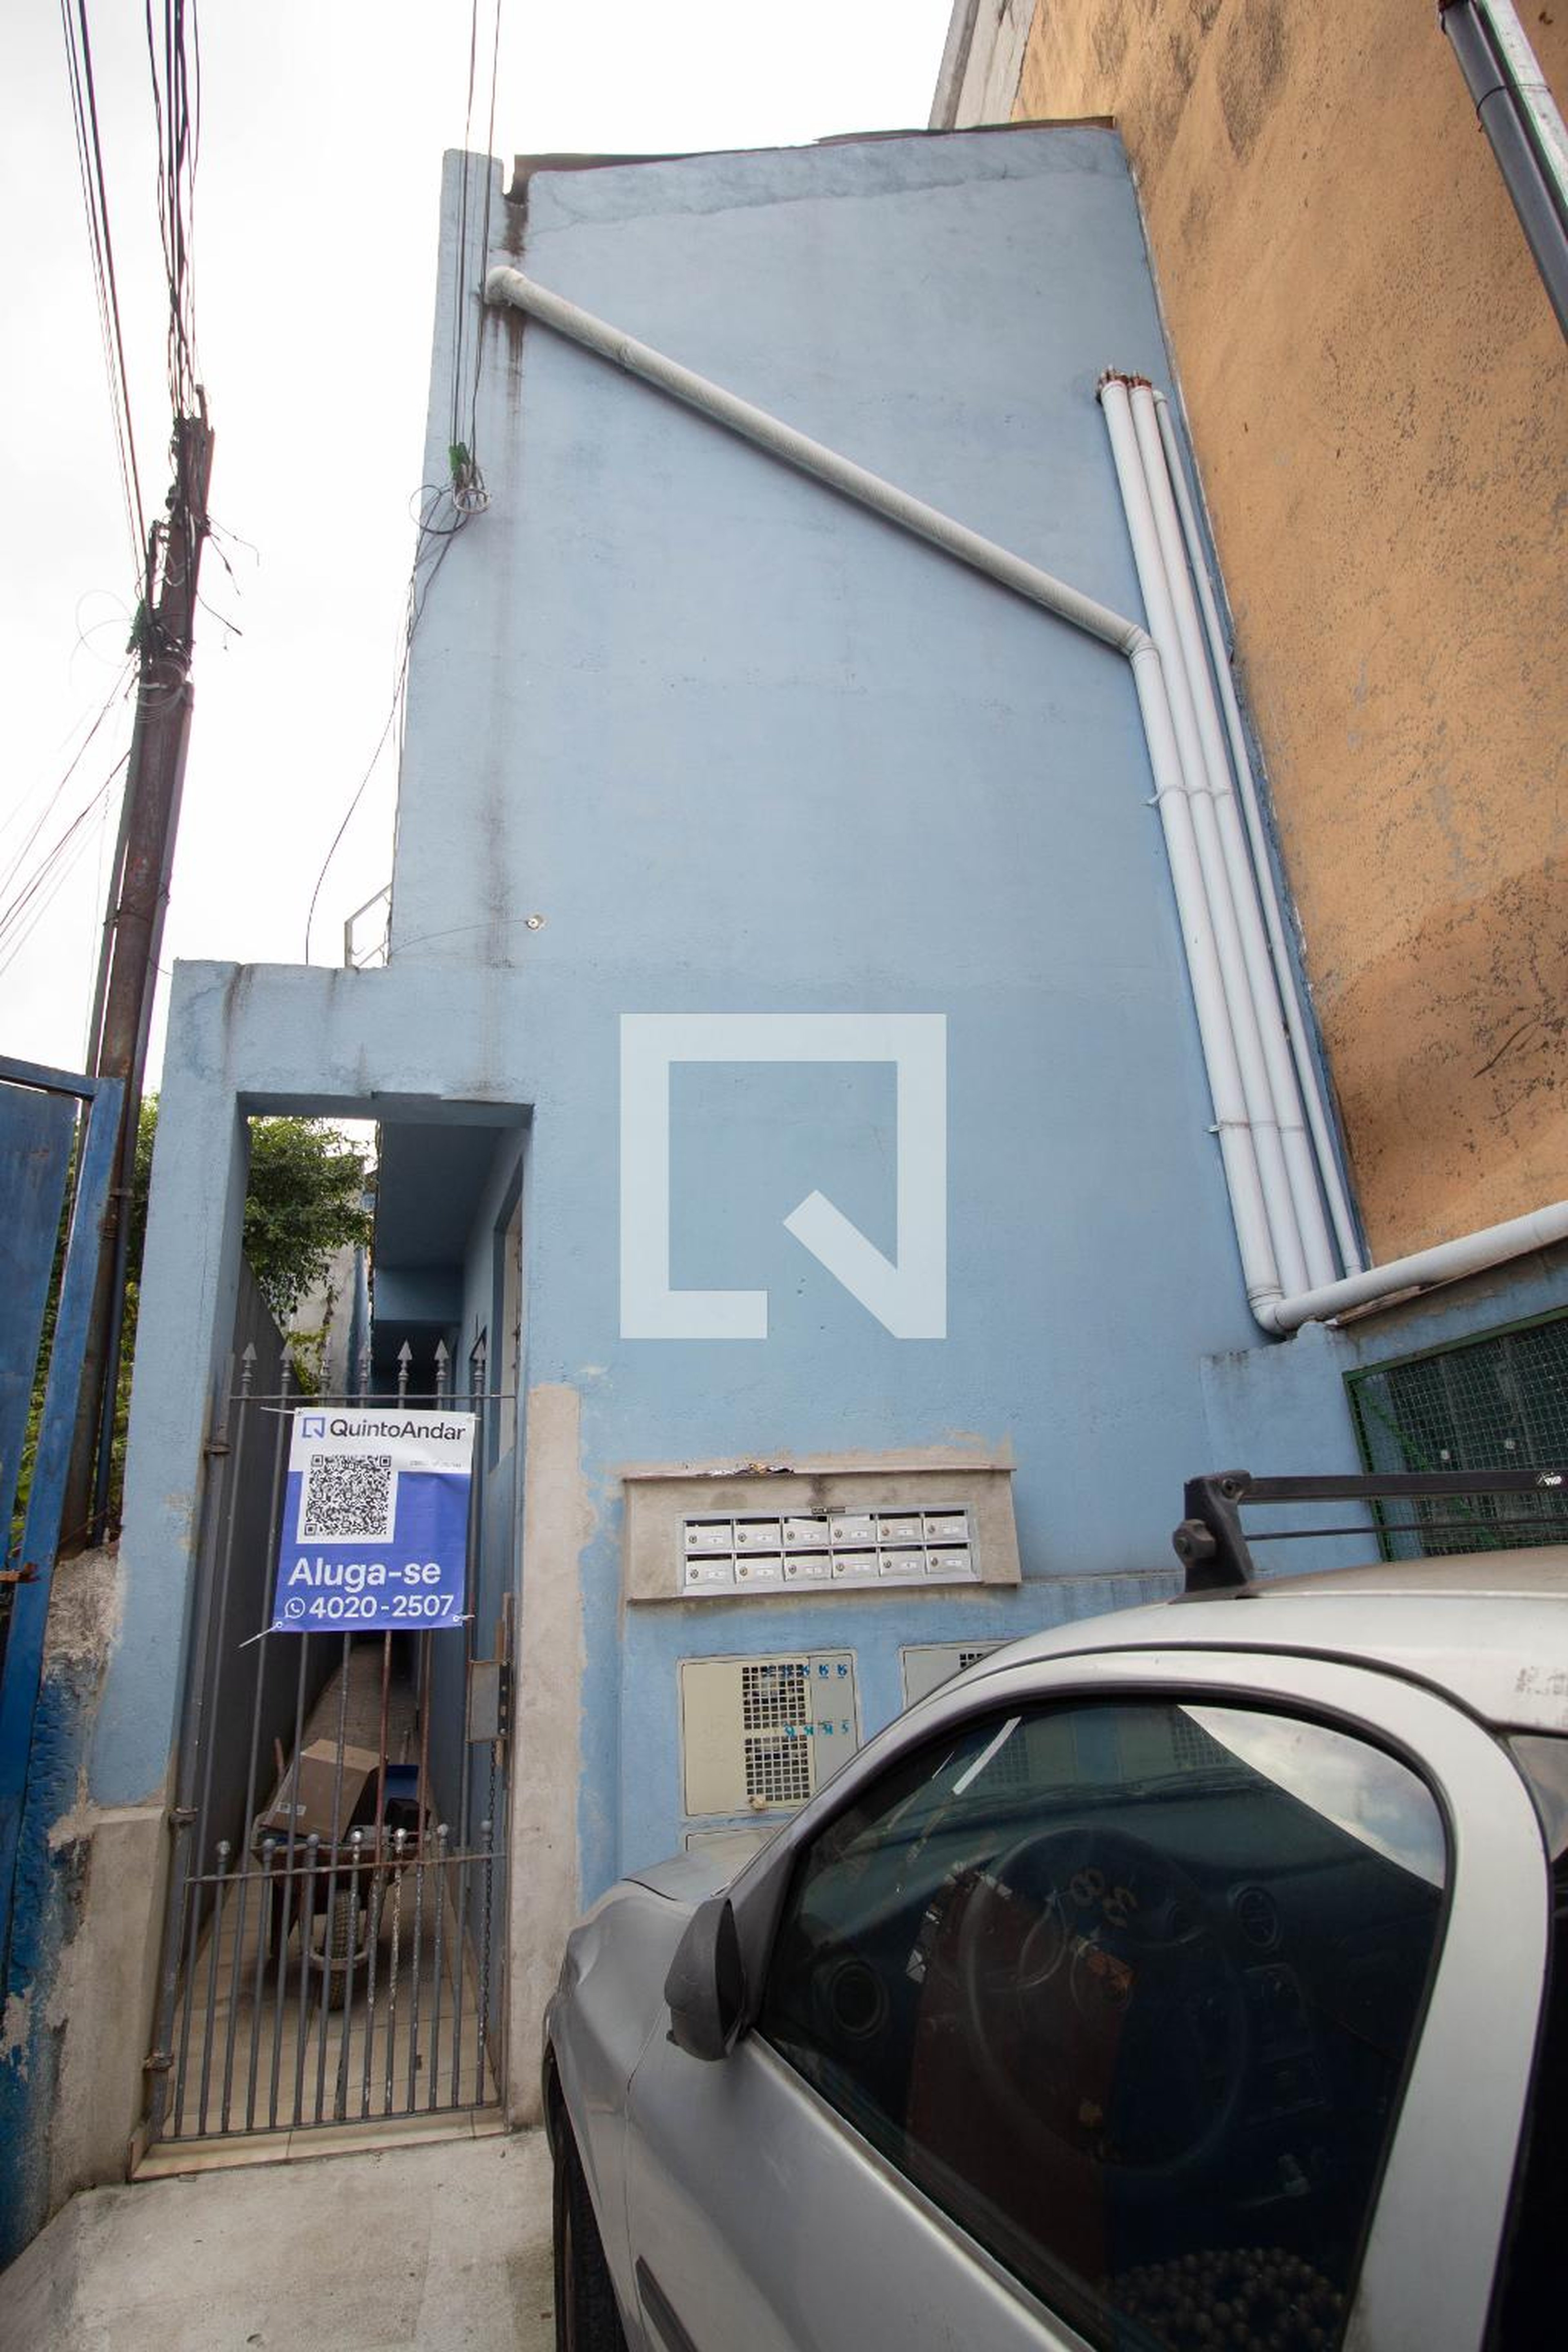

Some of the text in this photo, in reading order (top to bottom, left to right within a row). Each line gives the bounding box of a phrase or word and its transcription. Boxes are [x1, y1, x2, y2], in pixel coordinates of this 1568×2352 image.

[330, 1419, 466, 1441] QuintoAndar
[287, 1557, 441, 1593] Aluga-se
[309, 1594, 454, 1618] 4020-2507
